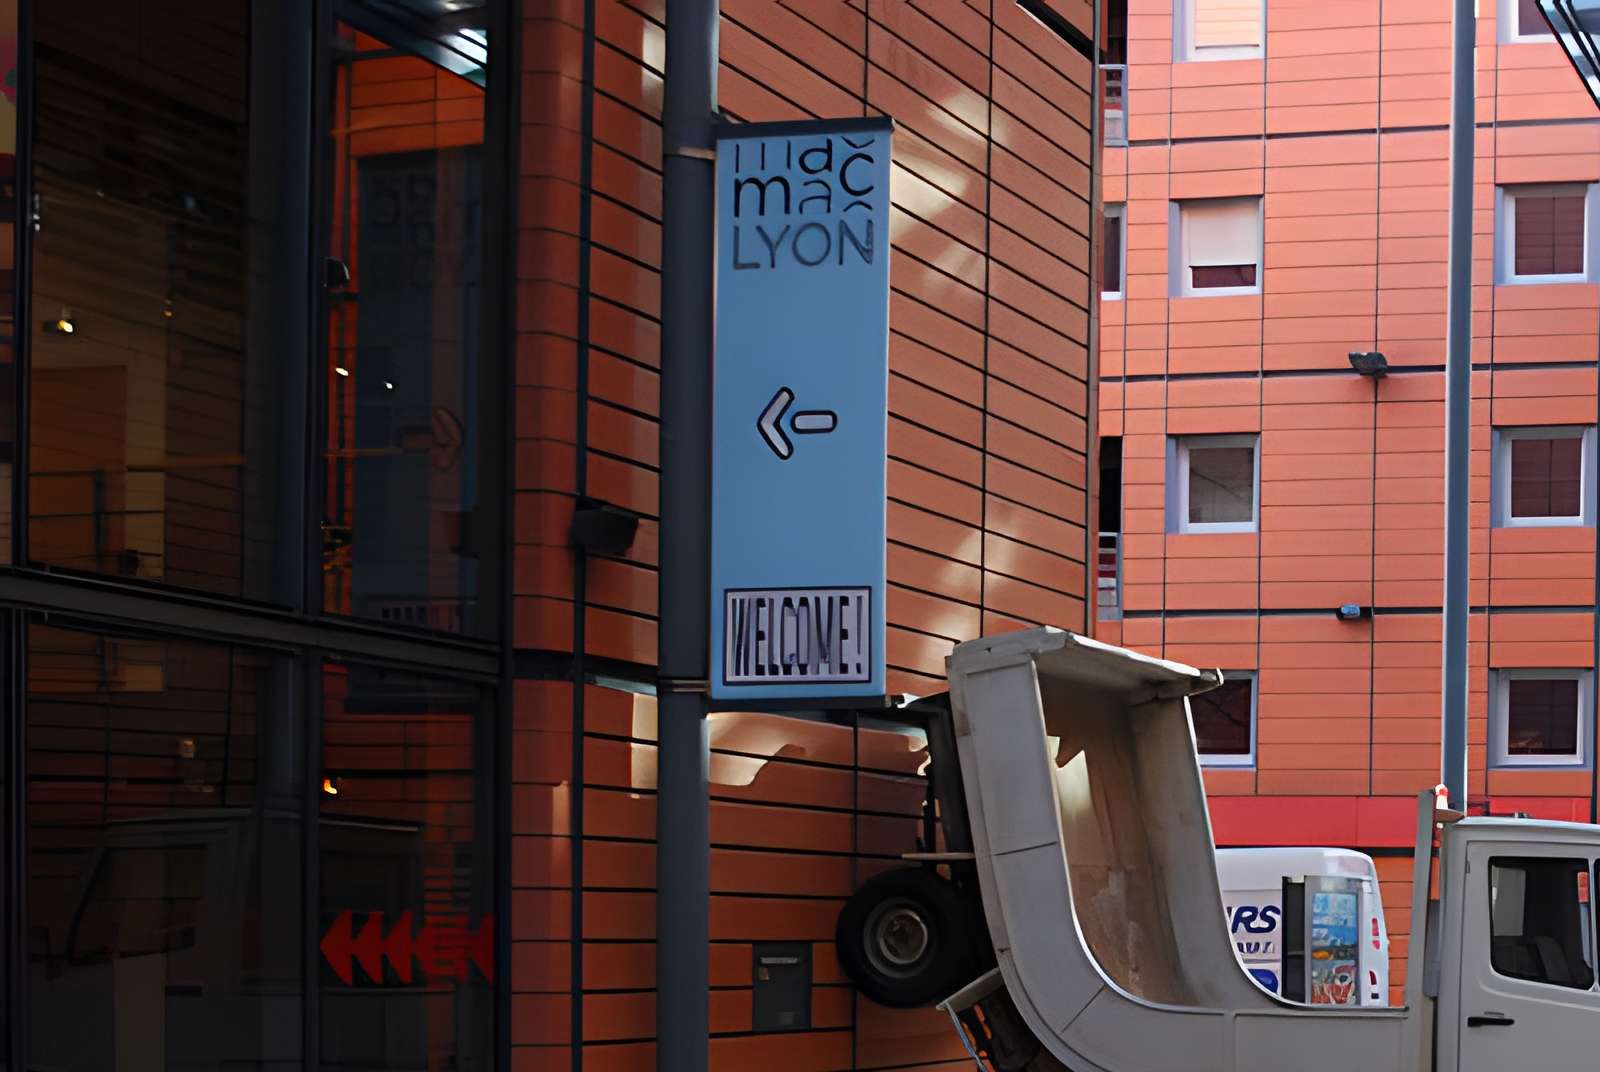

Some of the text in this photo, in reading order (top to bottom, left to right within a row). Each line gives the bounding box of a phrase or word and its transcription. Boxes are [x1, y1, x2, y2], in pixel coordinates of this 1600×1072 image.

[734, 219, 874, 269] LYON
[731, 596, 863, 676] WELCOME!
[1226, 905, 1281, 933] RS
